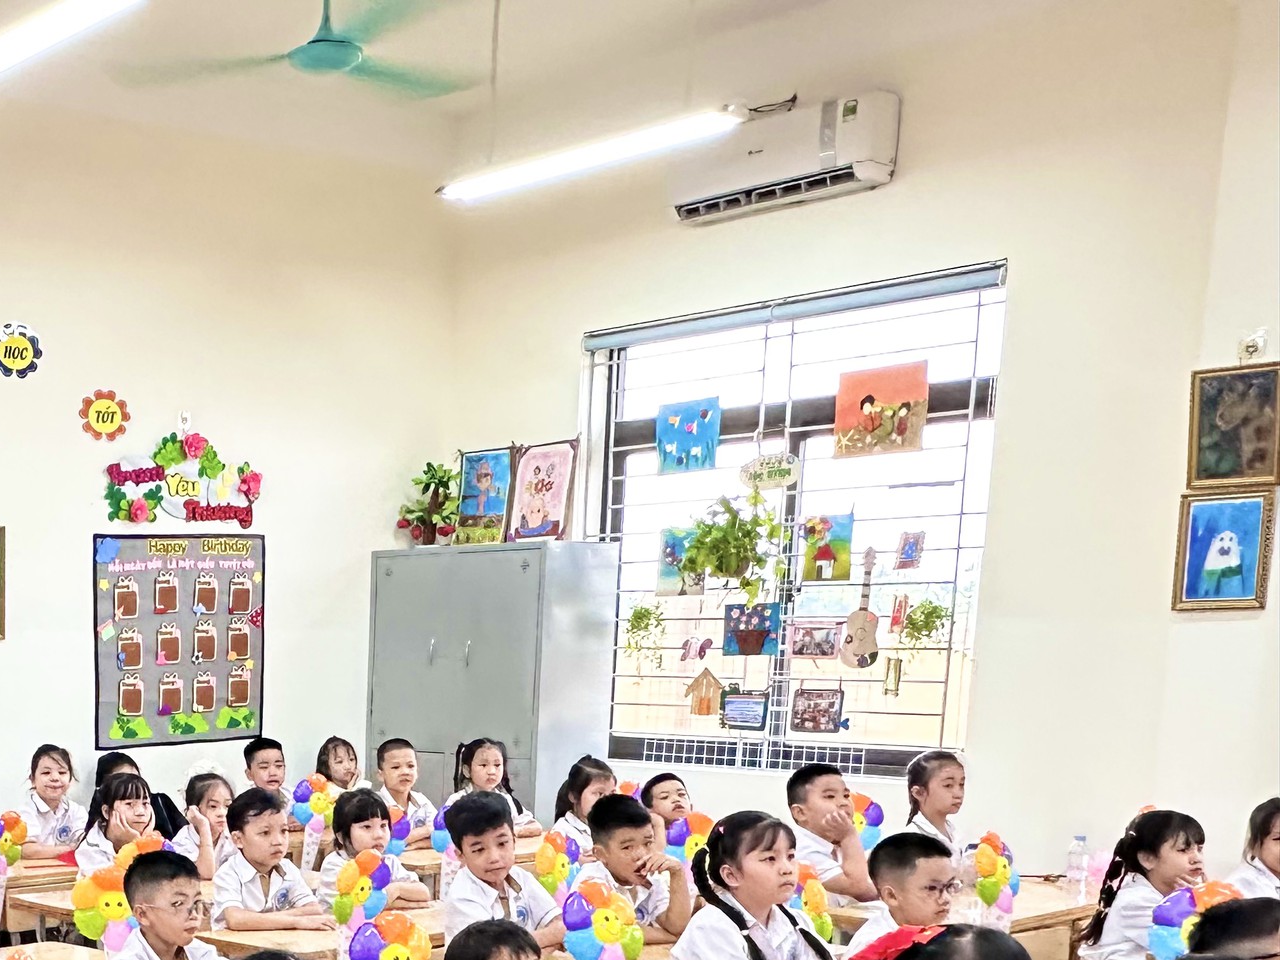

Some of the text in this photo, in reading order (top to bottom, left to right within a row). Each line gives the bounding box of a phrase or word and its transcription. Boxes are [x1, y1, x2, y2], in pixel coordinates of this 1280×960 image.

[3, 343, 28, 365] HỌC
[94, 402, 118, 424] TỐT
[148, 537, 253, 558] Happy Birthday
